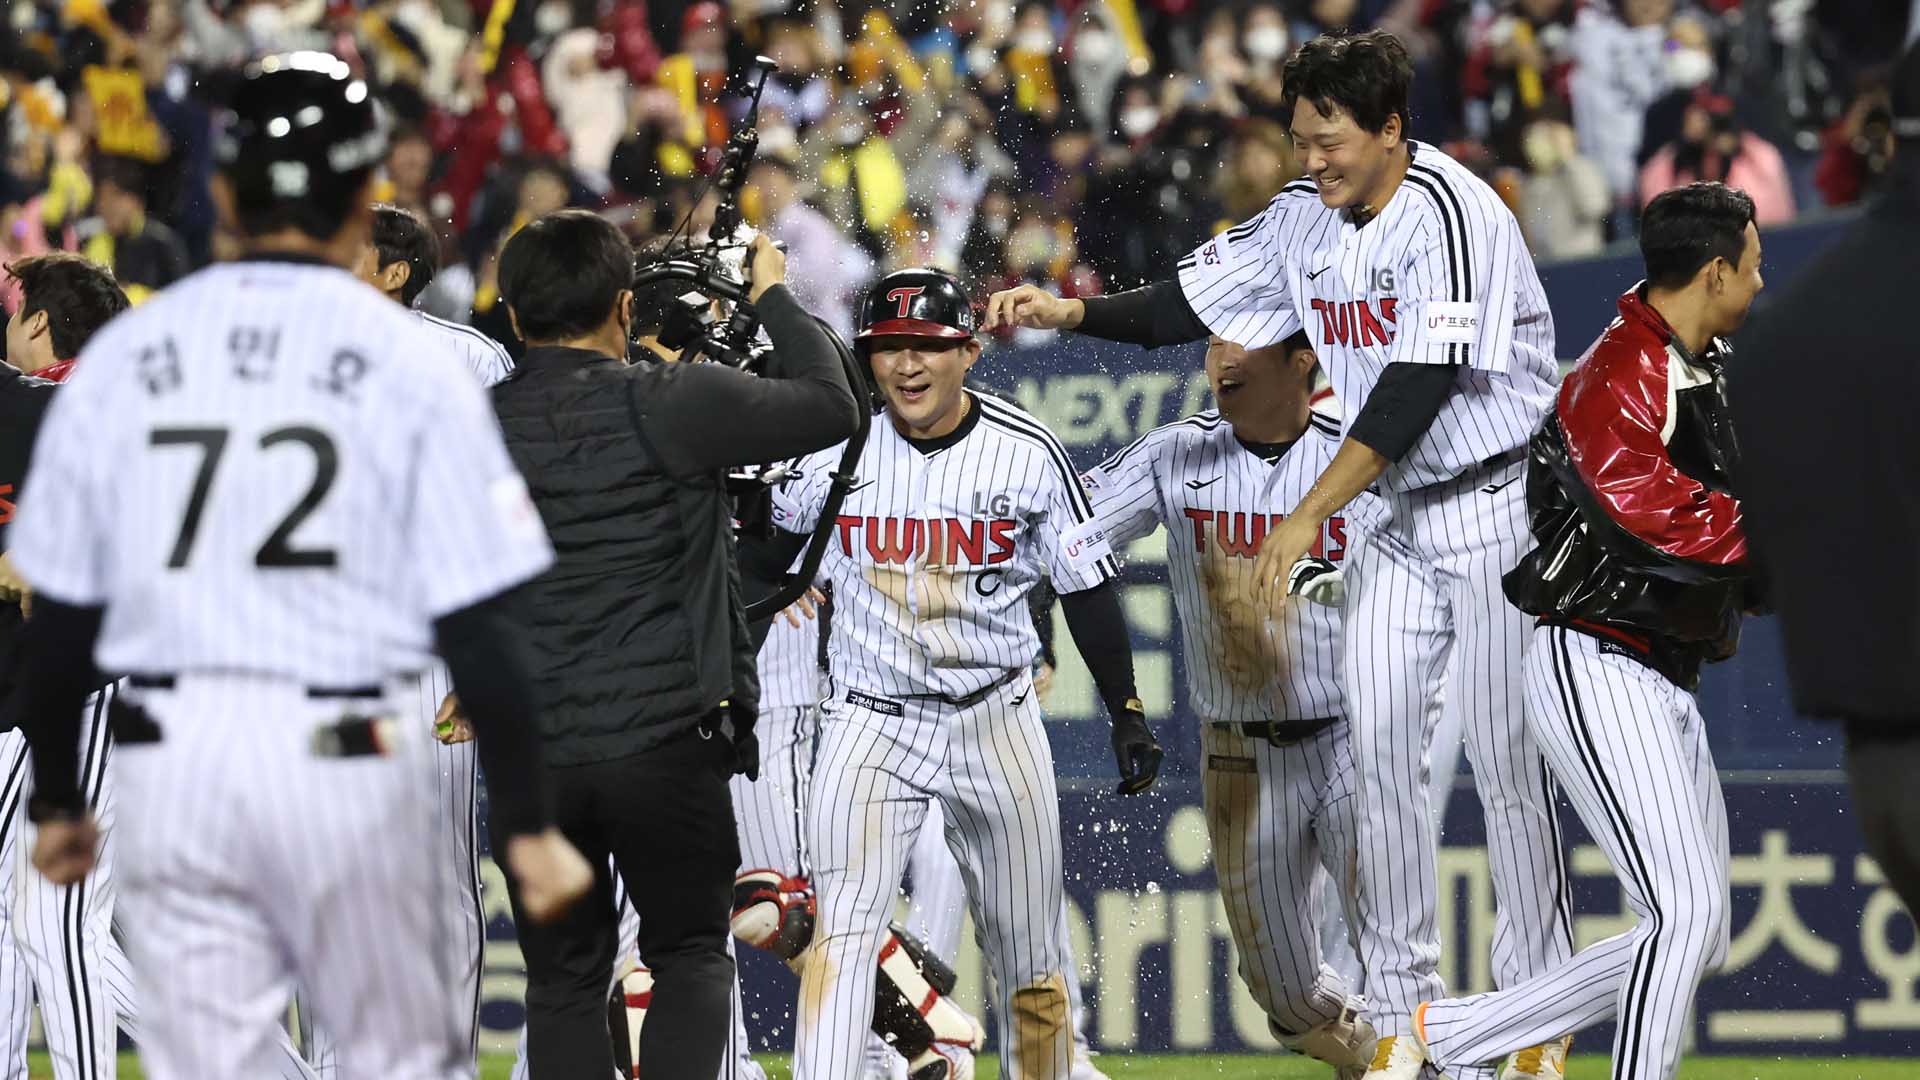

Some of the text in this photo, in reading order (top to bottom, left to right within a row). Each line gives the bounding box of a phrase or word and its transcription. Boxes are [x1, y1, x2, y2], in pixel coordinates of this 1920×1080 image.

[886, 285, 927, 318] T
[958, 312, 969, 327] LG
[1015, 371, 1181, 448] NEXT
[149, 425, 338, 569] 72
[974, 491, 1011, 518] LG
[833, 515, 1017, 567] TWINS
[974, 569, 1002, 597] C
